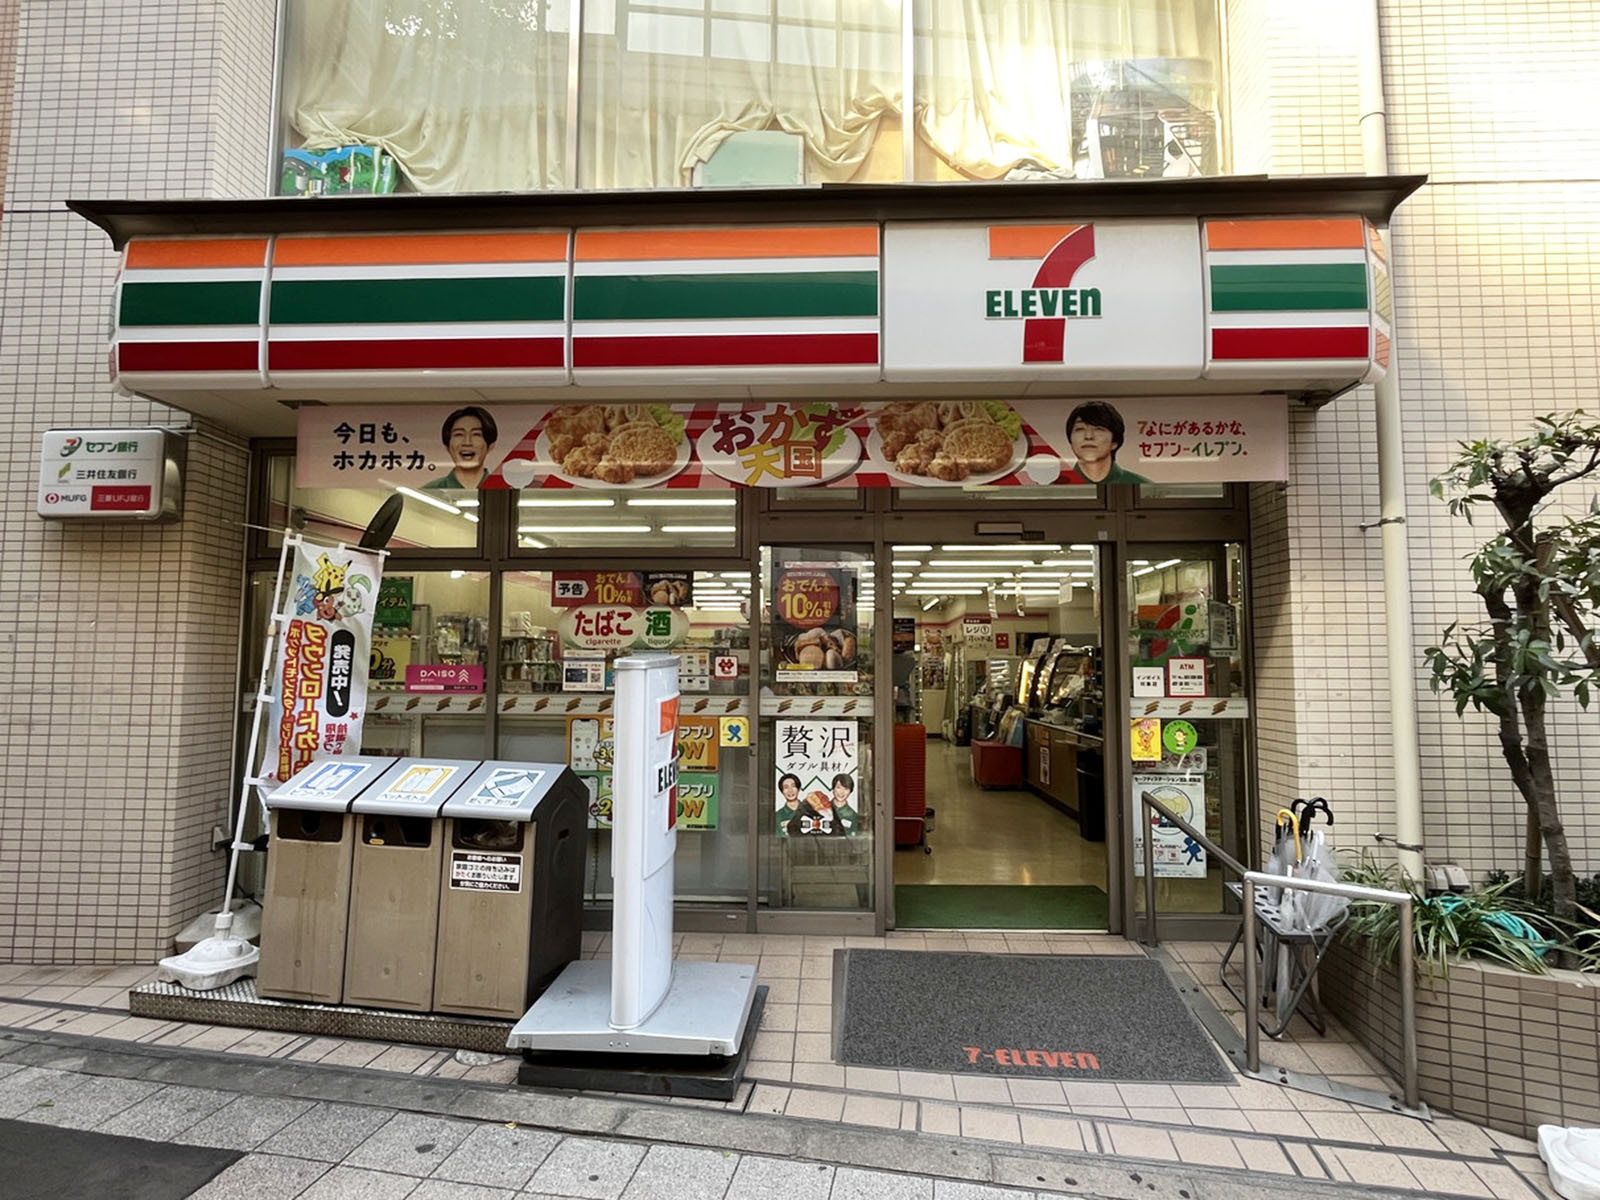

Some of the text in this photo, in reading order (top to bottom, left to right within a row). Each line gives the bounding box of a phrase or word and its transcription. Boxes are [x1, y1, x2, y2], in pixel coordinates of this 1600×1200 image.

[333, 423, 411, 444] 今日も、
[85, 441, 139, 453] セブン銀行
[333, 451, 437, 471] ホカホカ。
[737, 440, 823, 487] 天国
[76, 469, 138, 480] 三井住友銀行
[61, 494, 87, 503] MUFG
[558, 583, 583, 596] 予告
[574, 610, 671, 637] たばこ 酒
[585, 638, 671, 646] cigarette liquor
[420, 670, 456, 678] DAISO
[782, 724, 853, 759] 贅沢
